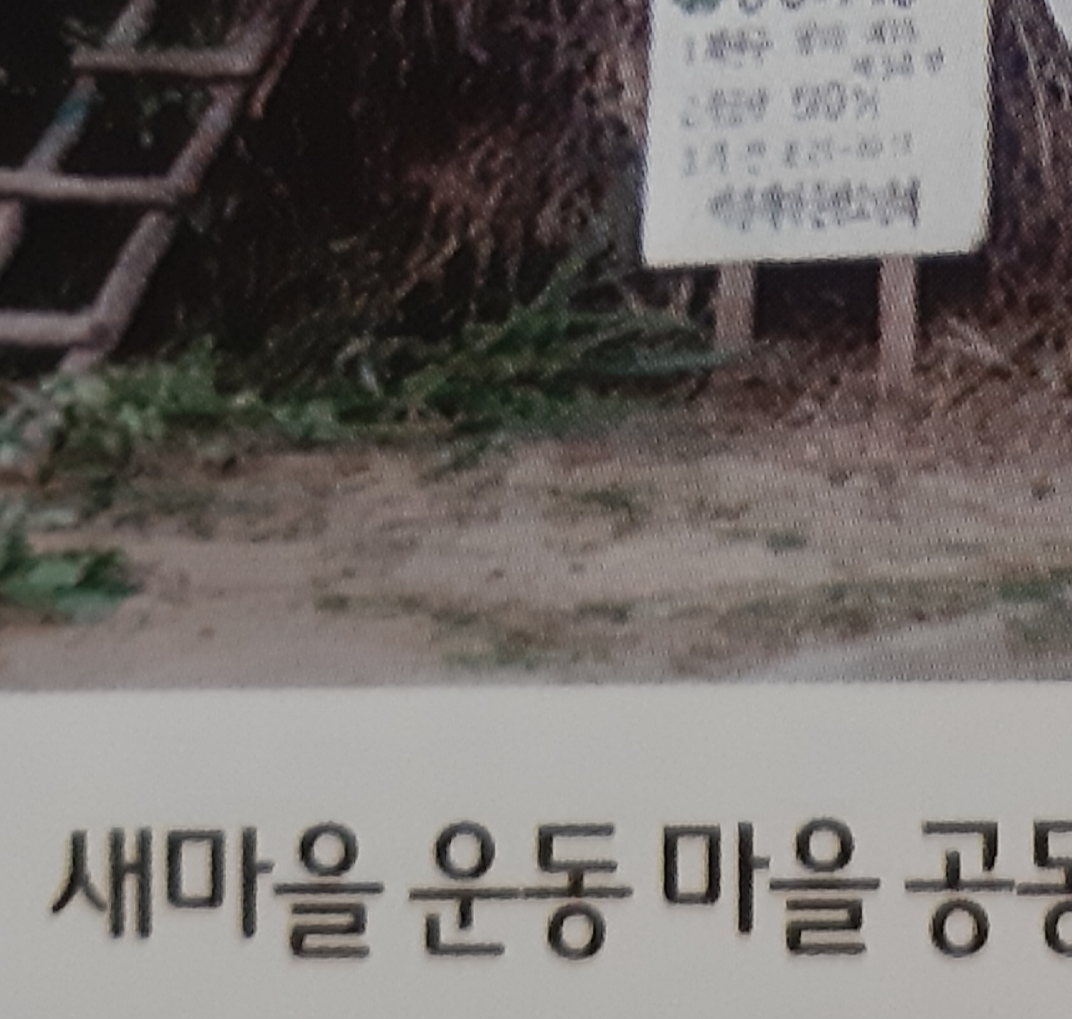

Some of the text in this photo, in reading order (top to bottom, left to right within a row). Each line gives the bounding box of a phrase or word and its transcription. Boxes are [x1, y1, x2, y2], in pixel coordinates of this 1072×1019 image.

[49, 822, 385, 960] 새마을
[407, 820, 634, 962] 운동
[660, 818, 881, 957] 마을
